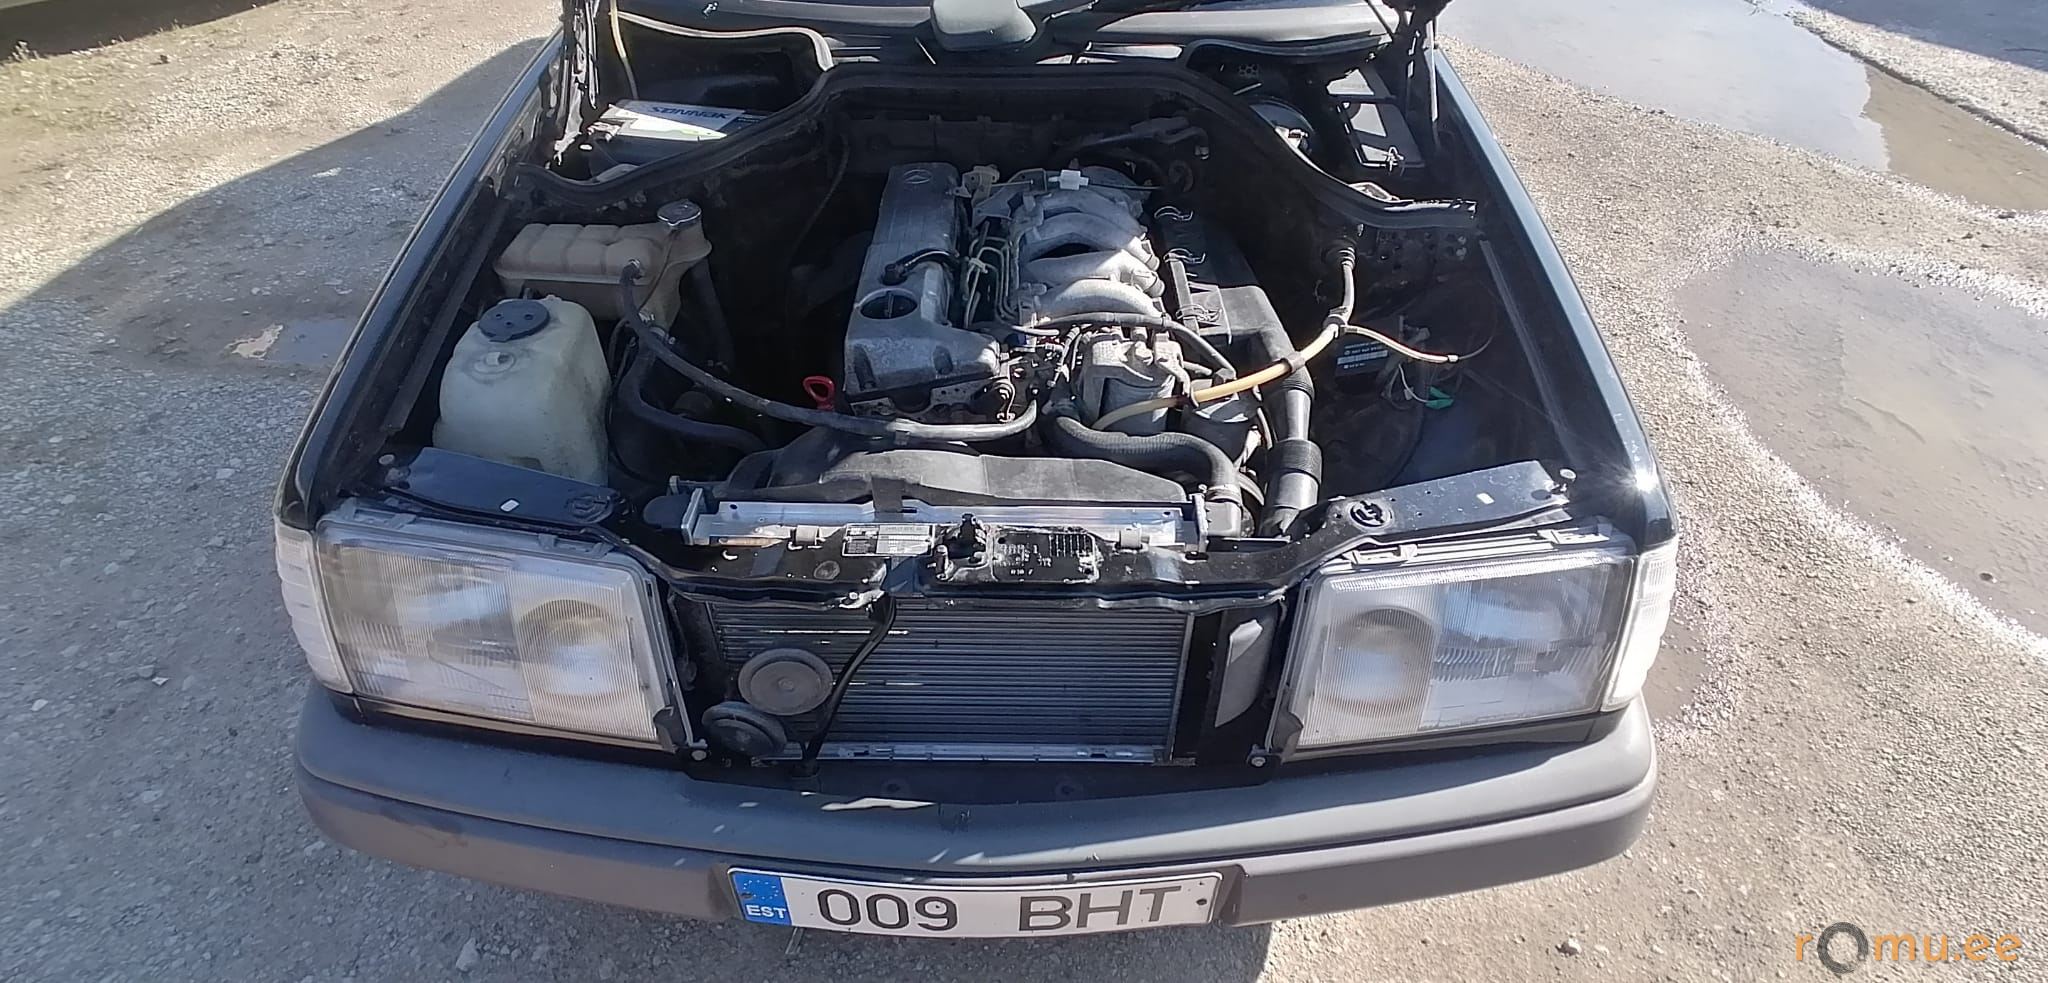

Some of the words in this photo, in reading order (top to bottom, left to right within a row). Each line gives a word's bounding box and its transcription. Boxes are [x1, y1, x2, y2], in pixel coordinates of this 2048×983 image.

[746, 903, 786, 920] EST
[816, 888, 957, 931] 009
[1018, 885, 1182, 932] BHT
